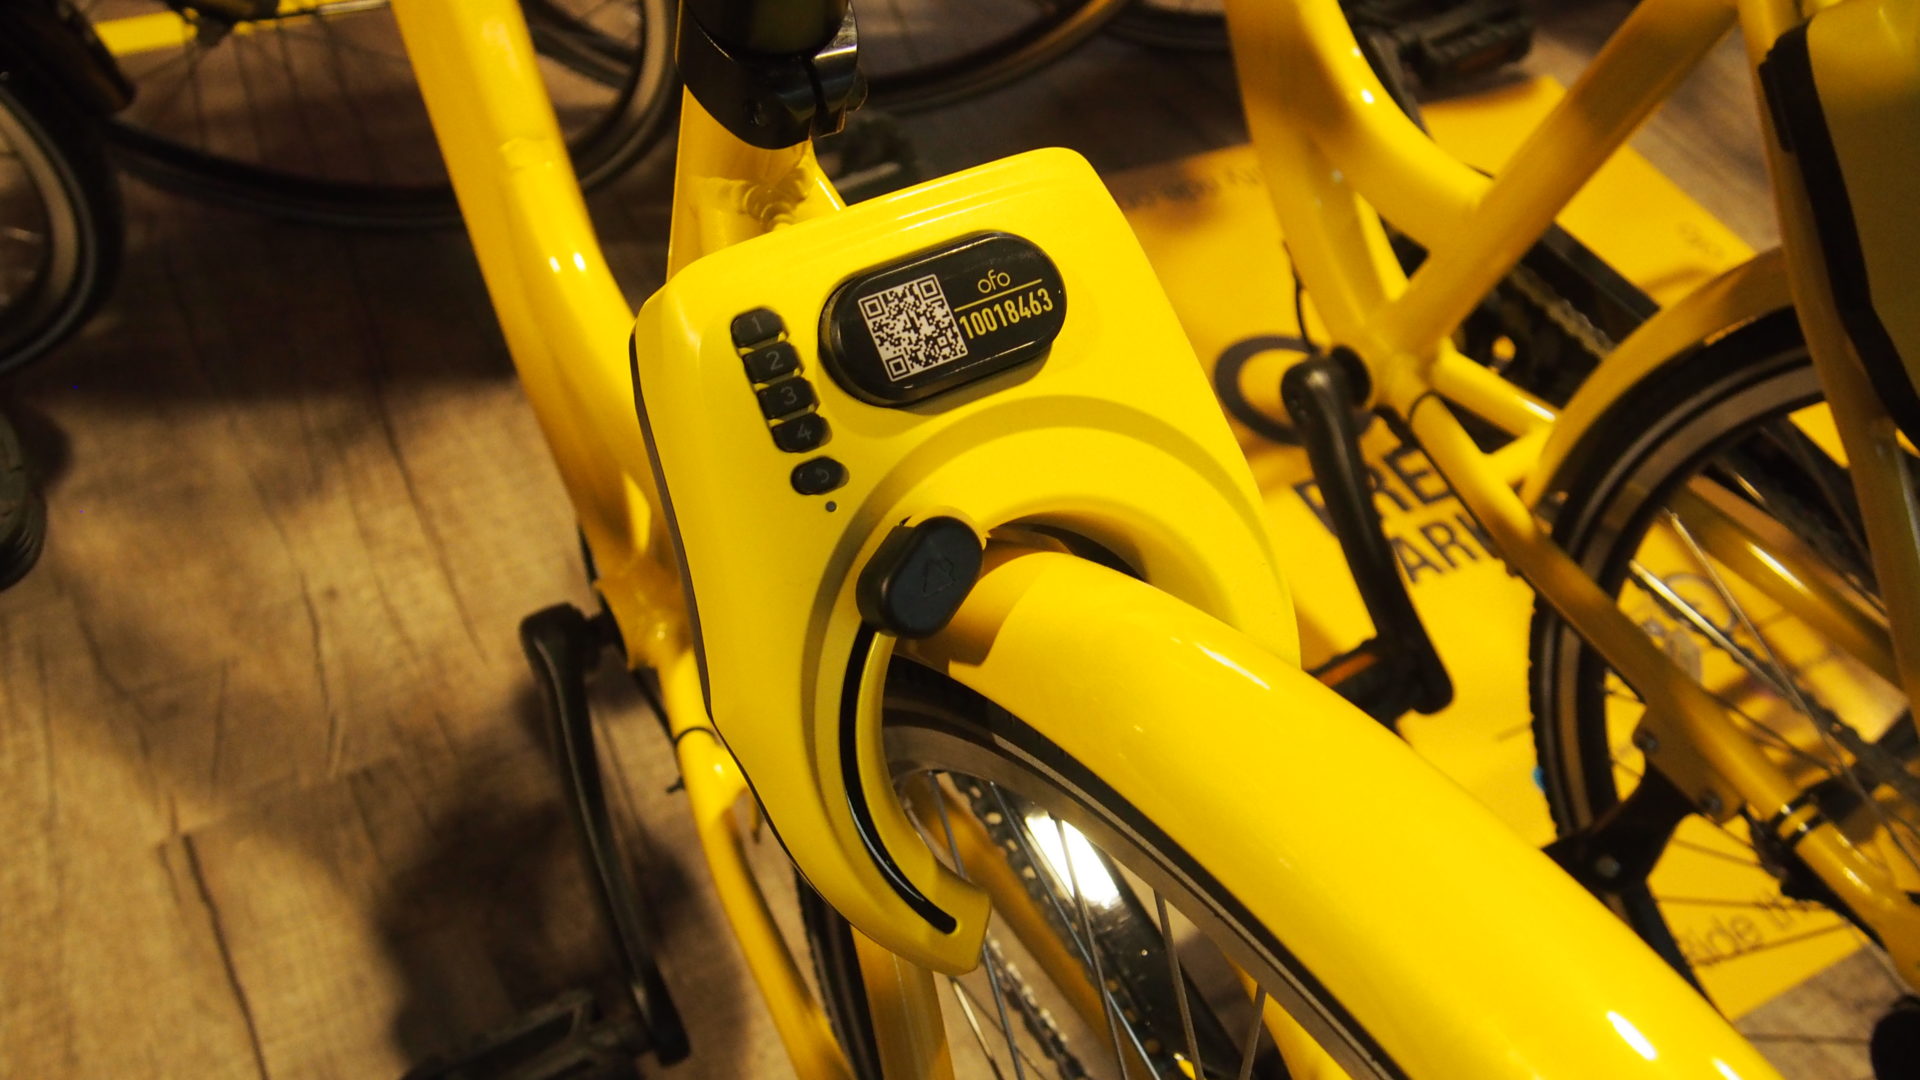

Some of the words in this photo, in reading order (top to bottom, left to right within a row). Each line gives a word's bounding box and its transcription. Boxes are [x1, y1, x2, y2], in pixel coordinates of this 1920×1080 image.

[977, 268, 1011, 294] ofo
[959, 288, 1054, 339] 10018463
[766, 350, 784, 371] 2
[780, 386, 797, 405] 3
[797, 423, 813, 440] 4
